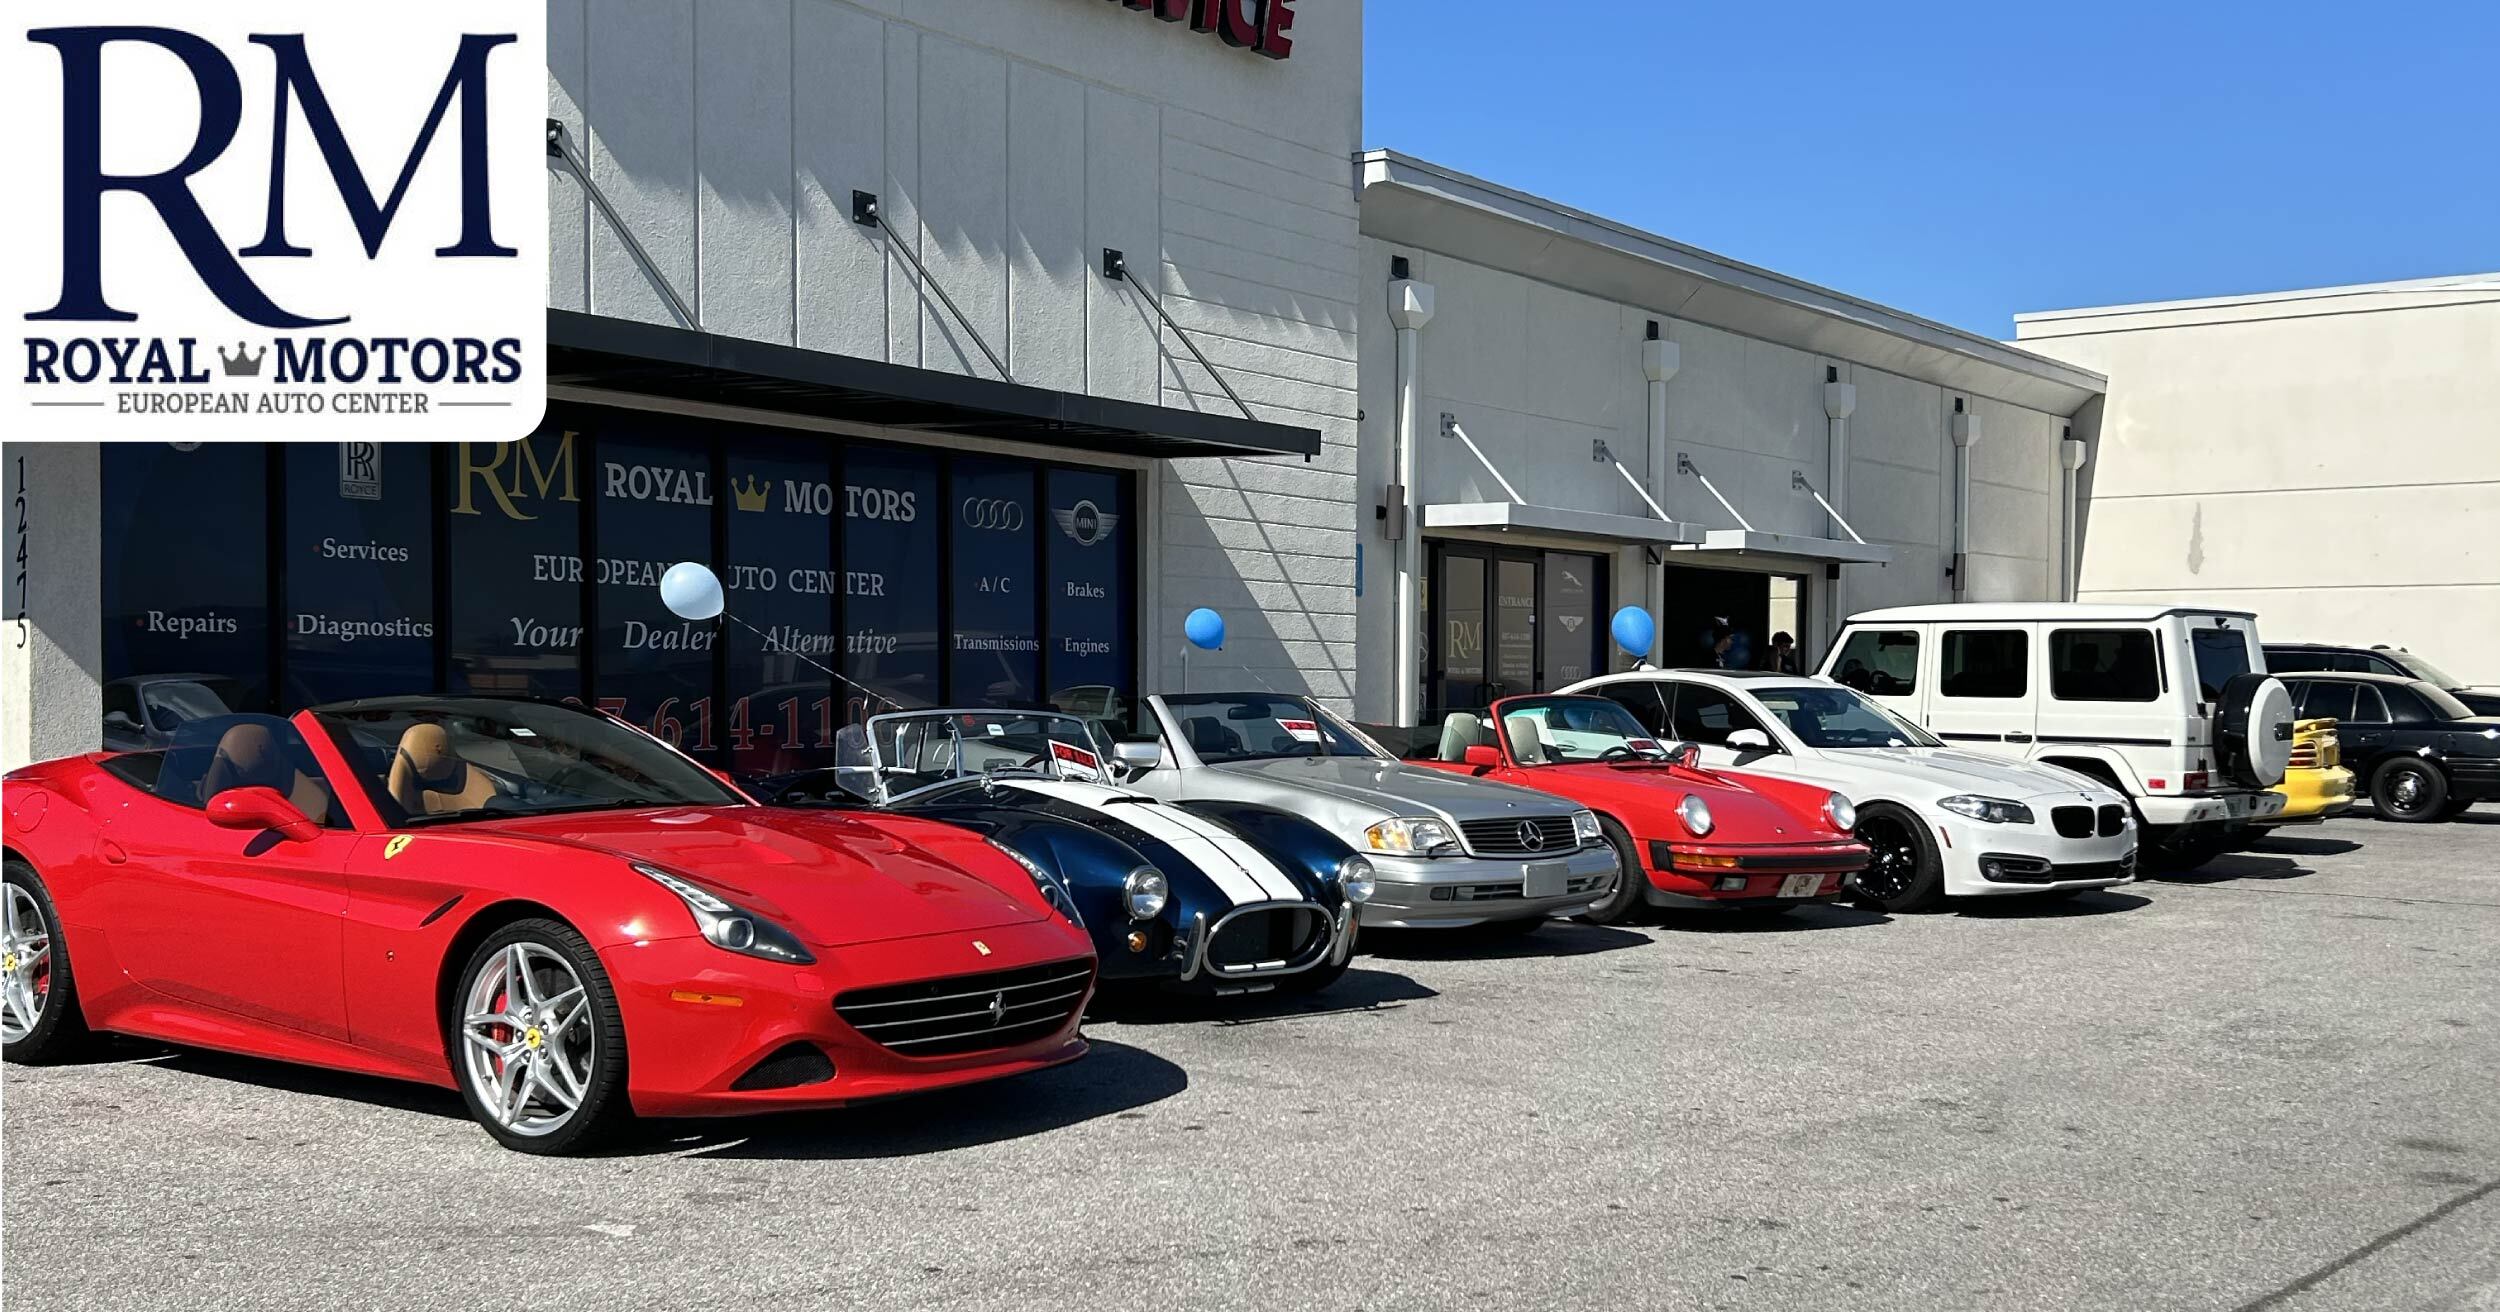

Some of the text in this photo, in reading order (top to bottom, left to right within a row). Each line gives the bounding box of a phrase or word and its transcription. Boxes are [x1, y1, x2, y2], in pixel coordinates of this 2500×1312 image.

[605, 462, 916, 522] ROYAL MOTORS
[1076, 518, 1097, 529] MINI
[15, 456, 28, 649] 12475
[322, 537, 409, 562] Services
[729, 565, 777, 591] UTO
[788, 569, 885, 596] CENTER
[1067, 581, 1105, 599] Brakes
[148, 610, 237, 634] Repairs
[298, 614, 433, 641] Diagnostics
[510, 616, 584, 648] Your
[623, 621, 717, 651] Dealer
[954, 634, 1040, 652] Transmissions
[1065, 637, 1110, 657] Engines
[1448, 620, 1481, 659] RM
